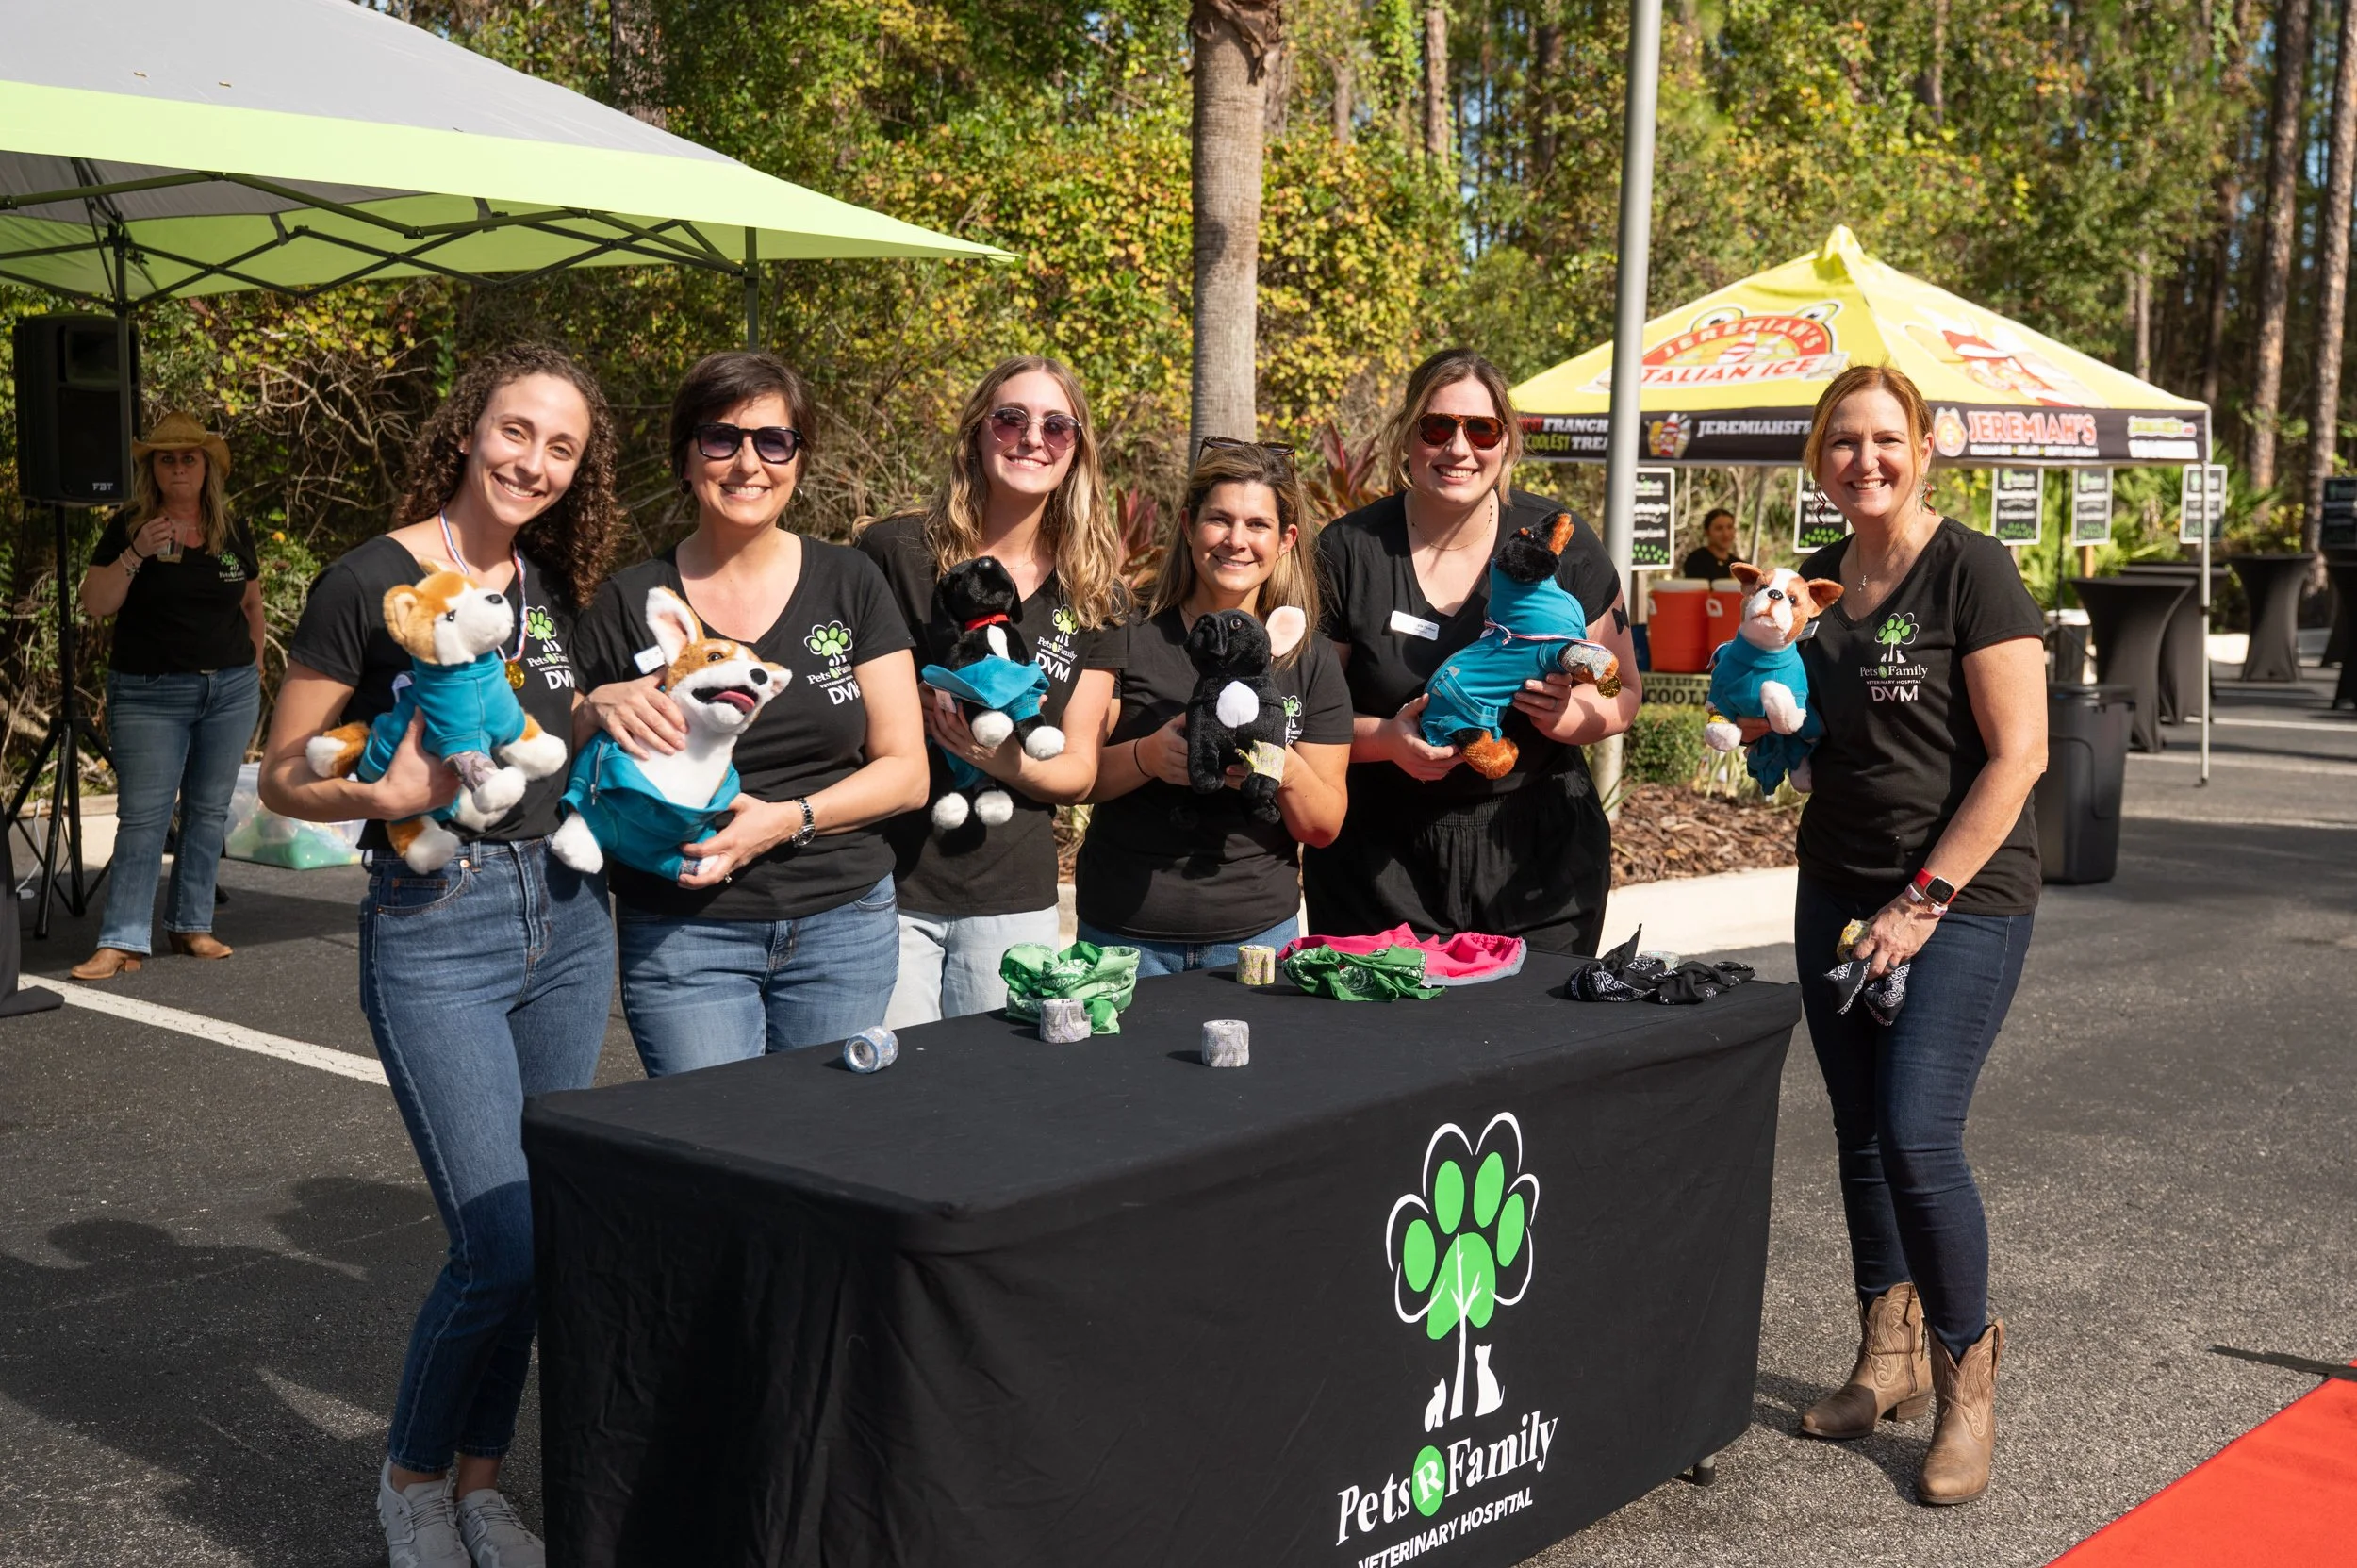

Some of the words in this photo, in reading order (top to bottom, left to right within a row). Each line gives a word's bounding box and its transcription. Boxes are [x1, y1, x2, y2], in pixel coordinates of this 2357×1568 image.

[1663, 317, 1822, 358] JEREMIAH'S
[1641, 364, 1753, 383] TALIAN
[1760, 356, 1818, 377] ICE
[1542, 418, 1609, 432] FRANCH
[1968, 411, 2097, 445] JEREMIAH'S
[526, 656, 549, 668] Pets
[1037, 636, 1052, 649] Pets
[1057, 644, 1078, 662] Family
[806, 671, 832, 685] Pets
[1035, 652, 1071, 683] DVM
[1860, 666, 1878, 677] Pets
[1887, 664, 1929, 679] Family
[1871, 685, 1919, 702] DVM
[1336, 1472, 1411, 1546] Pets
[1415, 1460, 1444, 1505] R
[1444, 1410, 1559, 1498] Family
[1460, 1487, 1533, 1535] HOSPITAL
